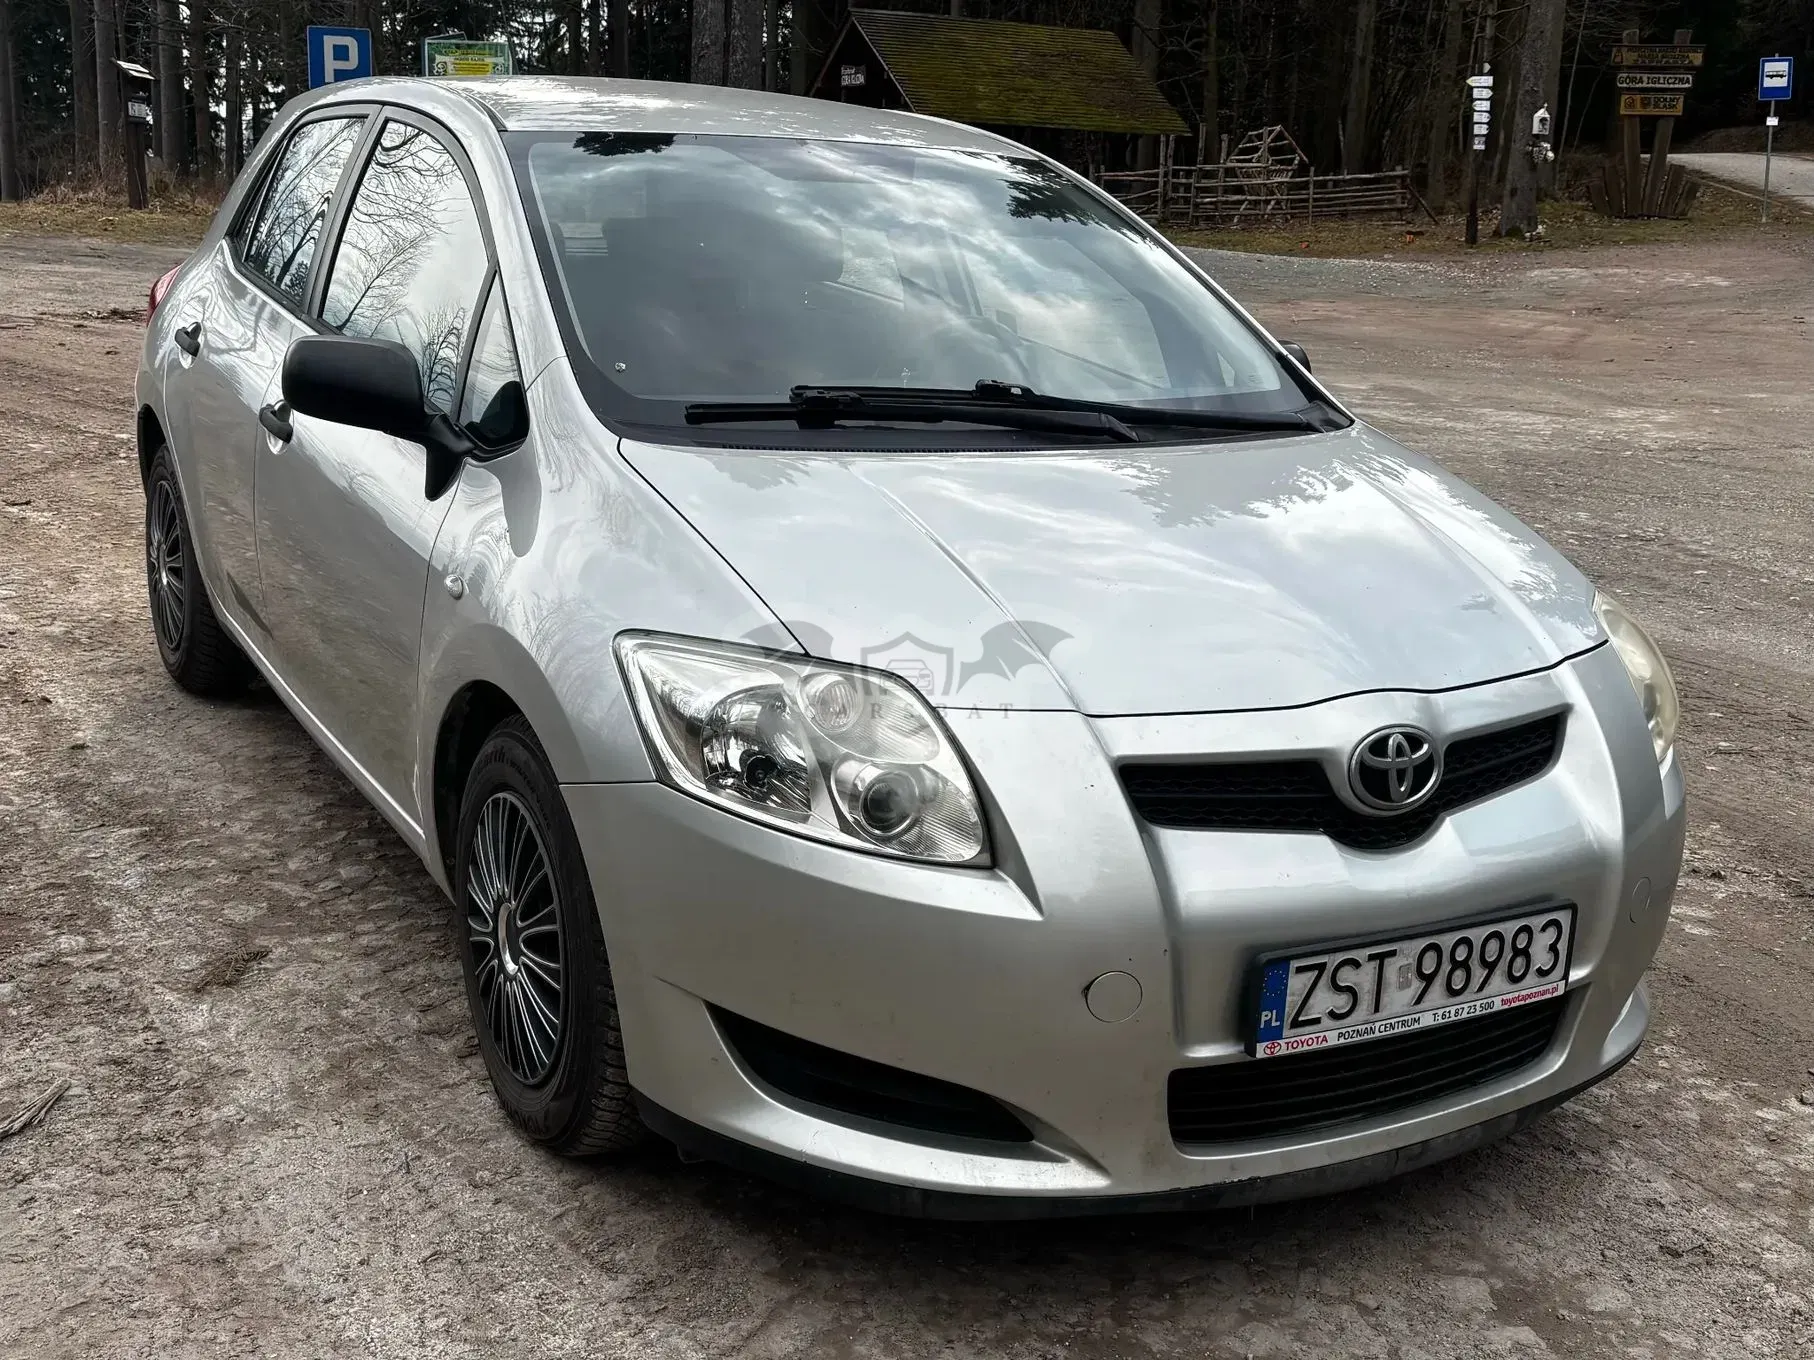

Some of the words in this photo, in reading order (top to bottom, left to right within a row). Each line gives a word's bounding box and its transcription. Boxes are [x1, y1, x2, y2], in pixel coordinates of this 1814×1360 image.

[323, 35, 359, 82] P
[1618, 75, 1644, 85] GÓRA
[1646, 75, 1691, 85] IGLICZNA
[1289, 949, 1398, 1029] ZST
[1411, 918, 1564, 1007] 98983
[1259, 1011, 1281, 1029] PL
[1284, 1034, 1329, 1051] TOYOTA
[1337, 1022, 1377, 1042] POZNAŃ
[1378, 1016, 1421, 1034] CENTRUM
[1441, 1009, 1451, 1020] 61
[1454, 1007, 1465, 1018] 87
[1466, 1005, 1477, 1015] 23
[1479, 1000, 1495, 1012] 500
[1500, 984, 1559, 1007] toyotapoznan.pl
